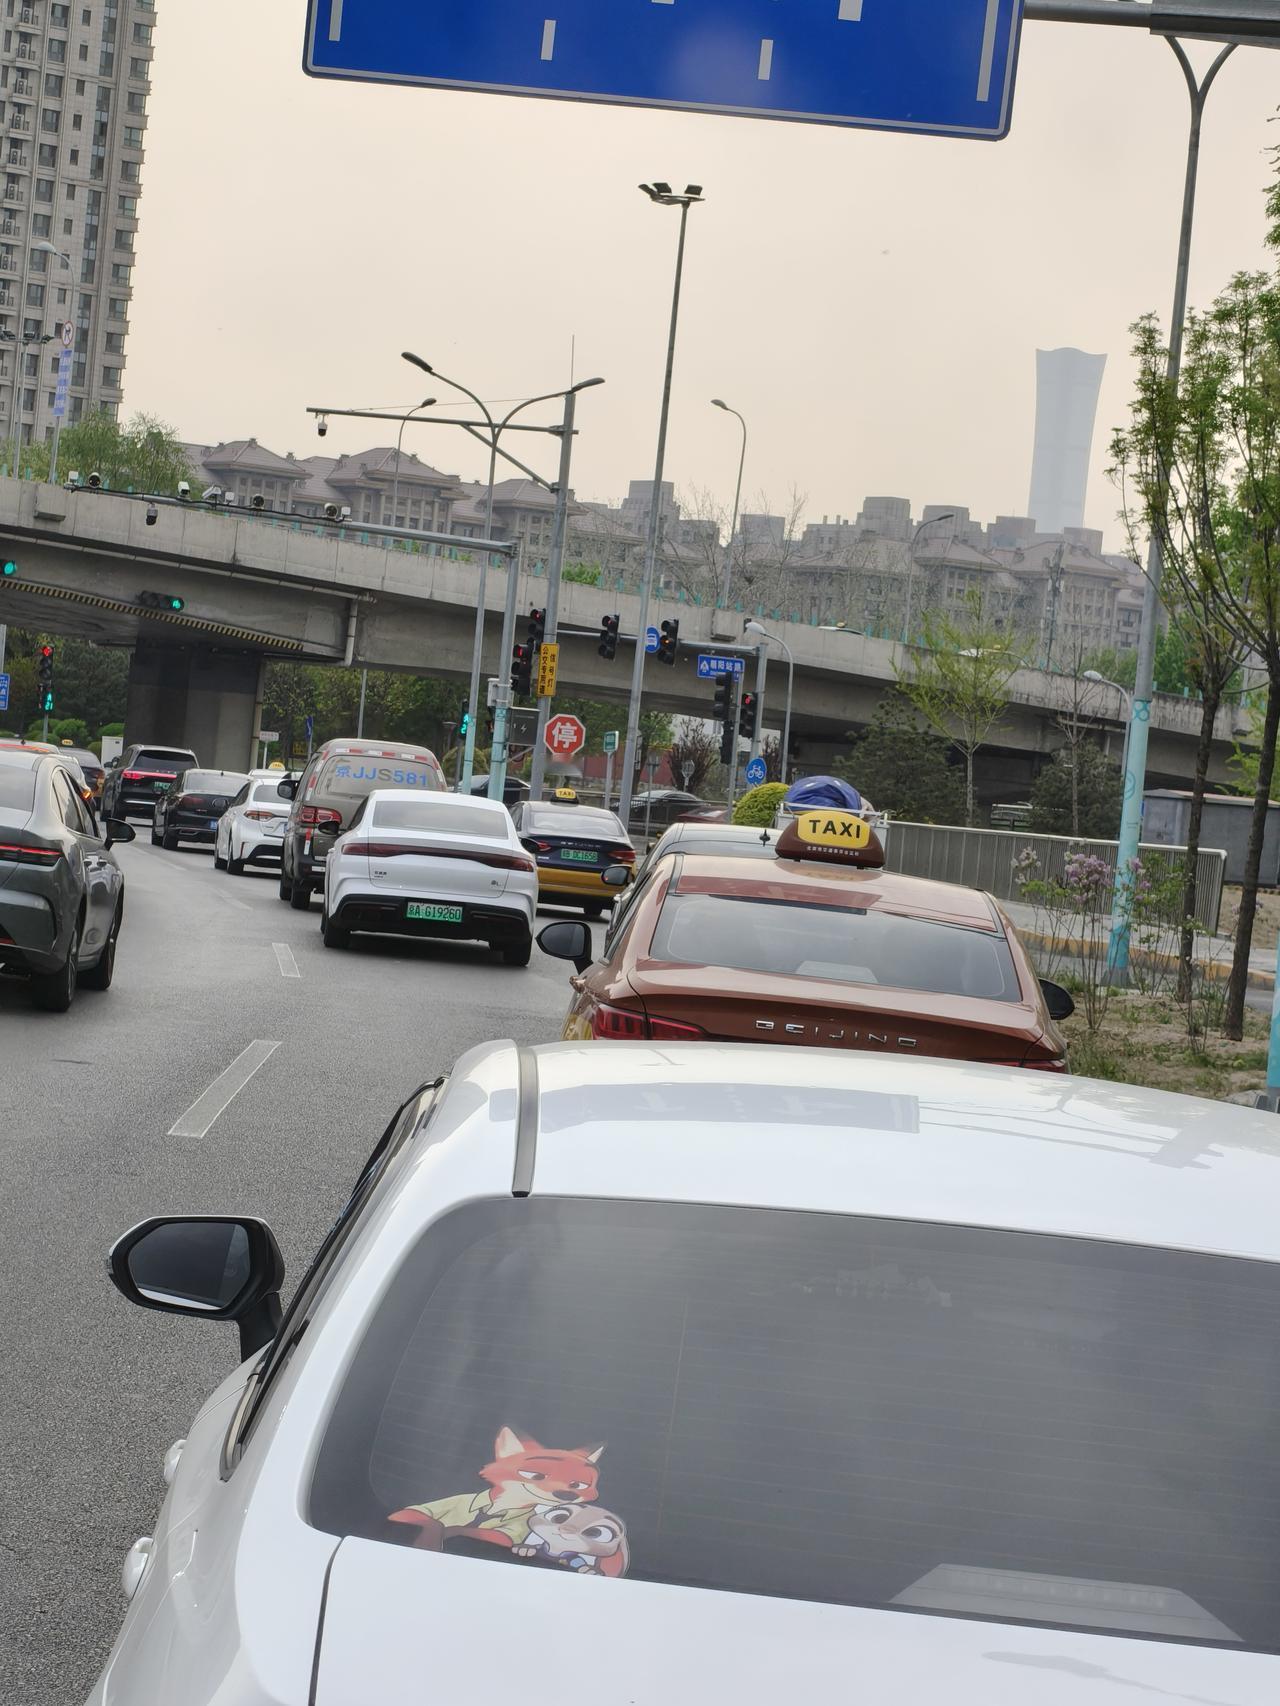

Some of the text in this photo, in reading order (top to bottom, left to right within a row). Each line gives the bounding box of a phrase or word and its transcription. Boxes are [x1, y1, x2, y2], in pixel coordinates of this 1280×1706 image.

[552, 721, 577, 748] 停
[336, 765, 427, 786] 京JJS581
[809, 819, 861, 839] TAXI
[755, 1020, 917, 1047] BEIJING
